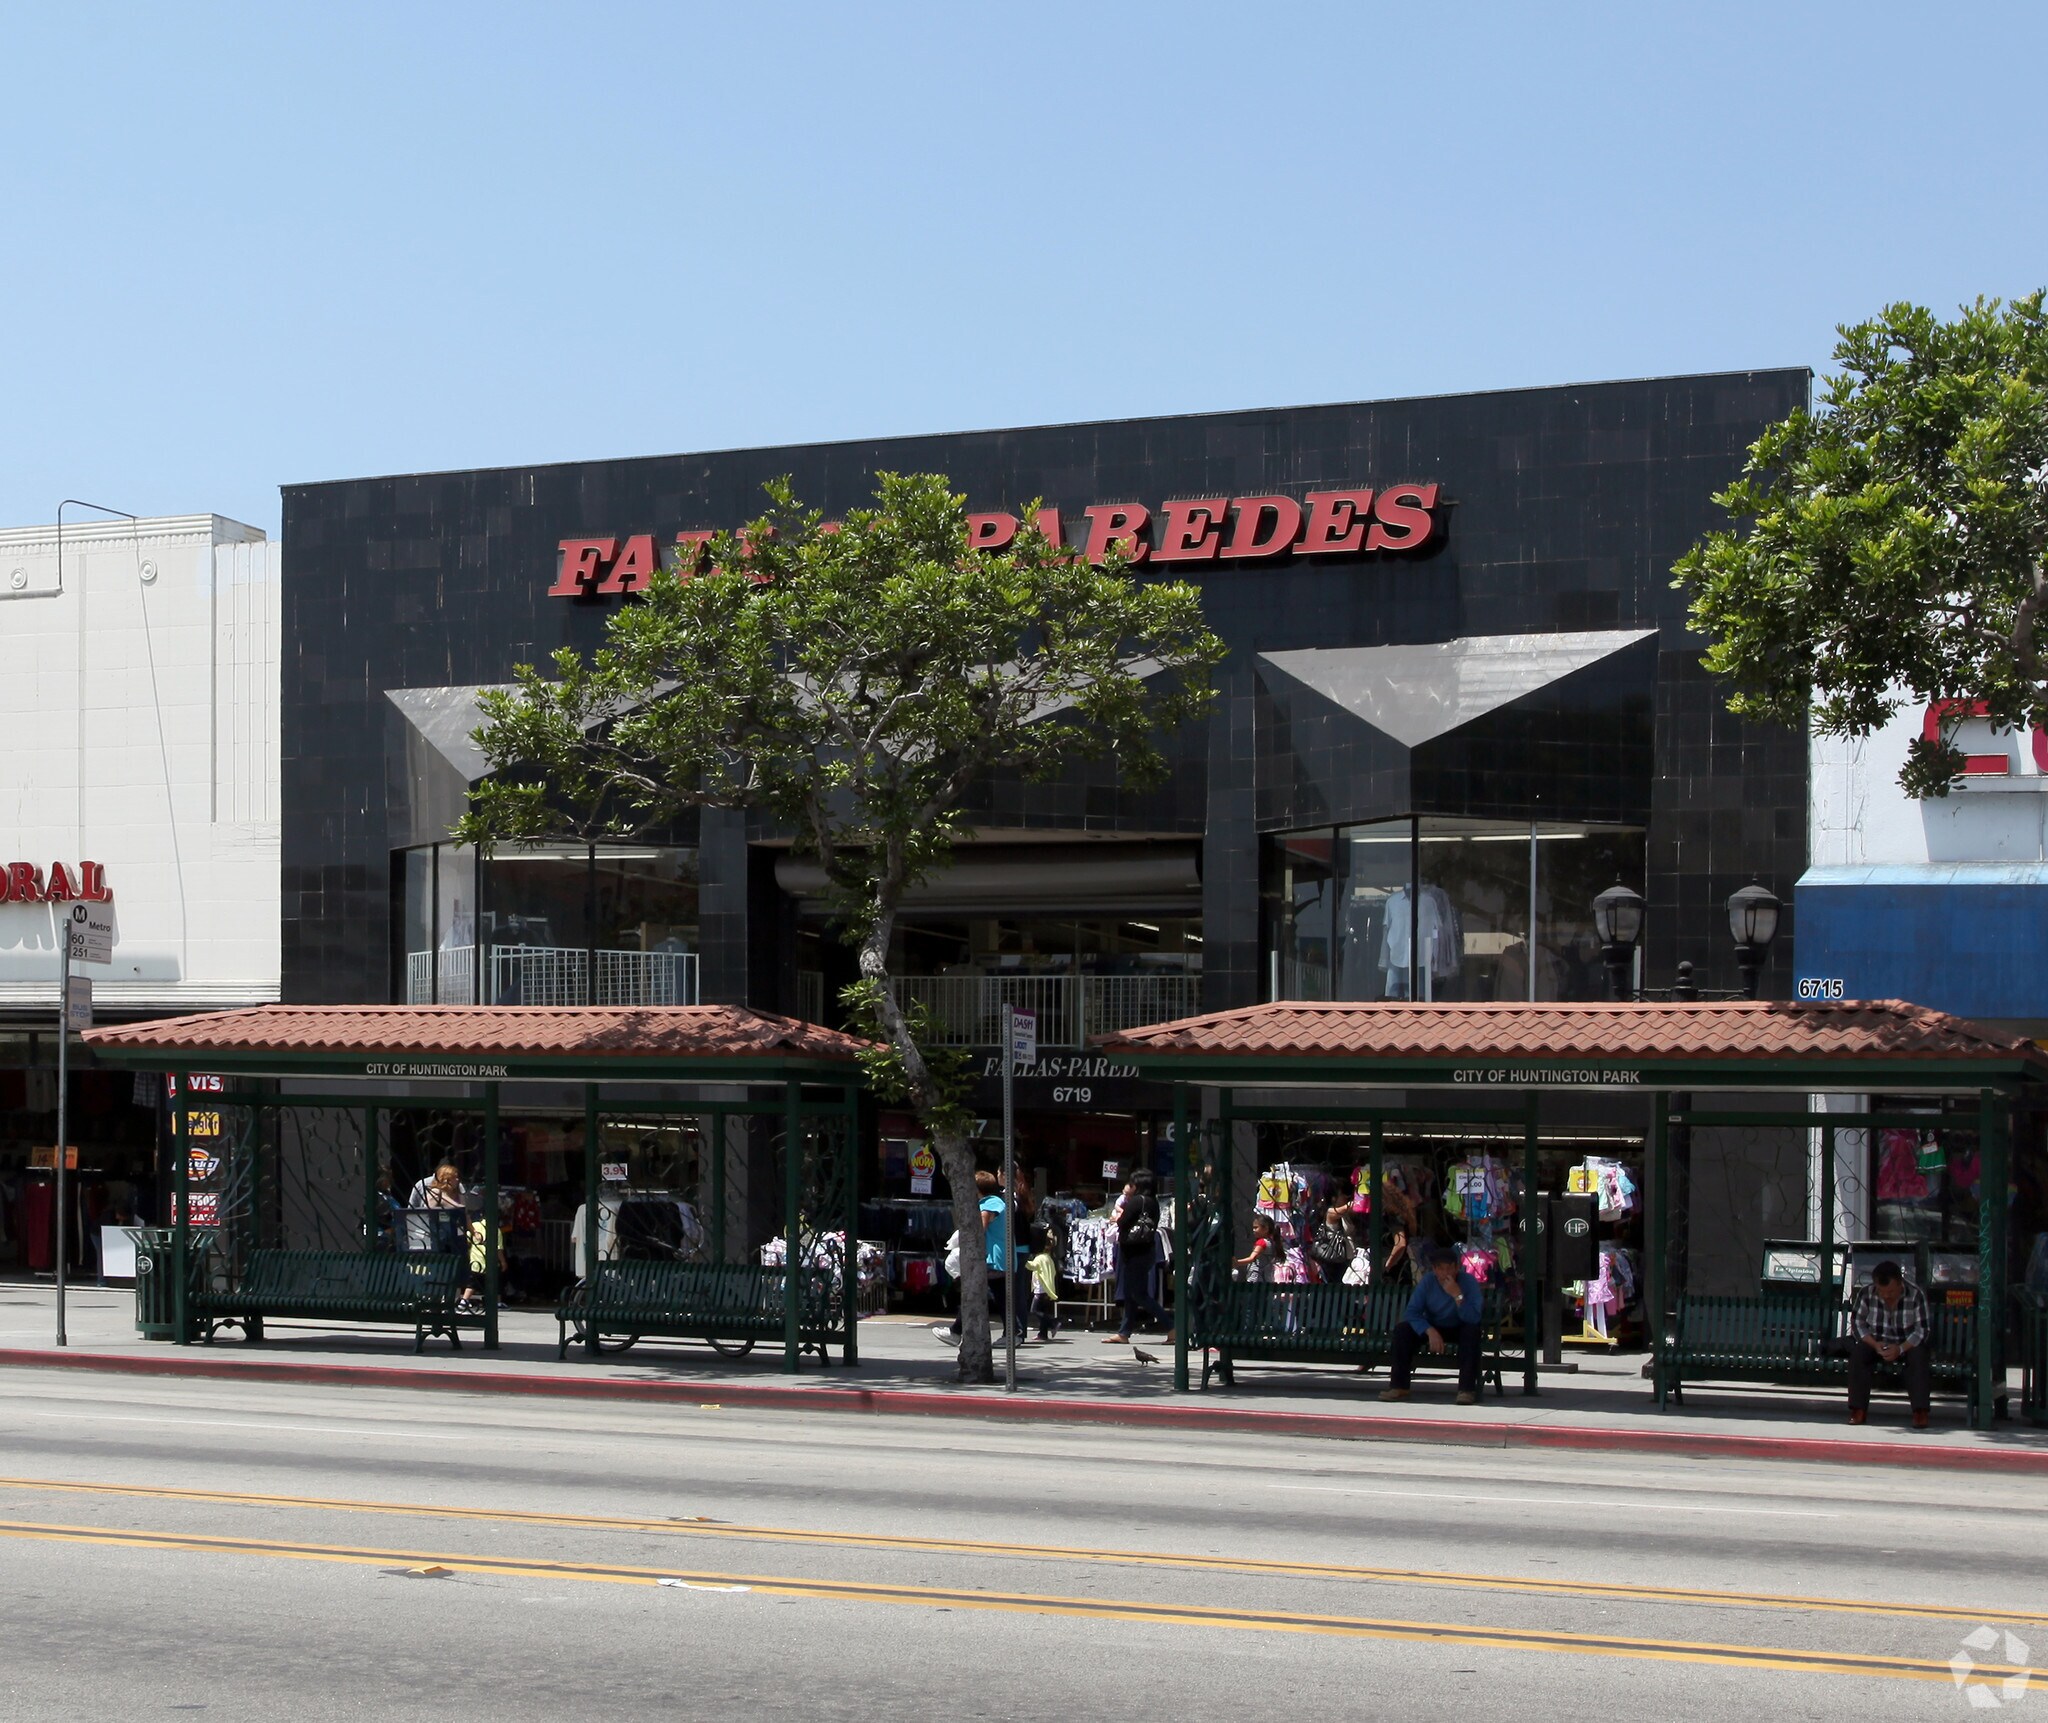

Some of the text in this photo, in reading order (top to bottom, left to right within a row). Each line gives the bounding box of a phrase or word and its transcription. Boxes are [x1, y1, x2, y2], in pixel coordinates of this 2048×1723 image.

[0, 861, 114, 902] RAL
[88, 921, 112, 933] Metro
[71, 934, 85, 945] 60
[72, 947, 88, 958] 251
[1798, 978, 1844, 1000] 6715
[70, 1010, 90, 1018] STOP
[1013, 1017, 1034, 1031] DASH
[366, 1063, 508, 1077] CITY OF HUNTINGTON PARK
[1453, 1069, 1640, 1084] CITY OF HUNTINGTON PARK
[1052, 1086, 1093, 1103] 6719
[603, 1166, 626, 1176] 3.99
[1567, 1222, 1586, 1234] HP
